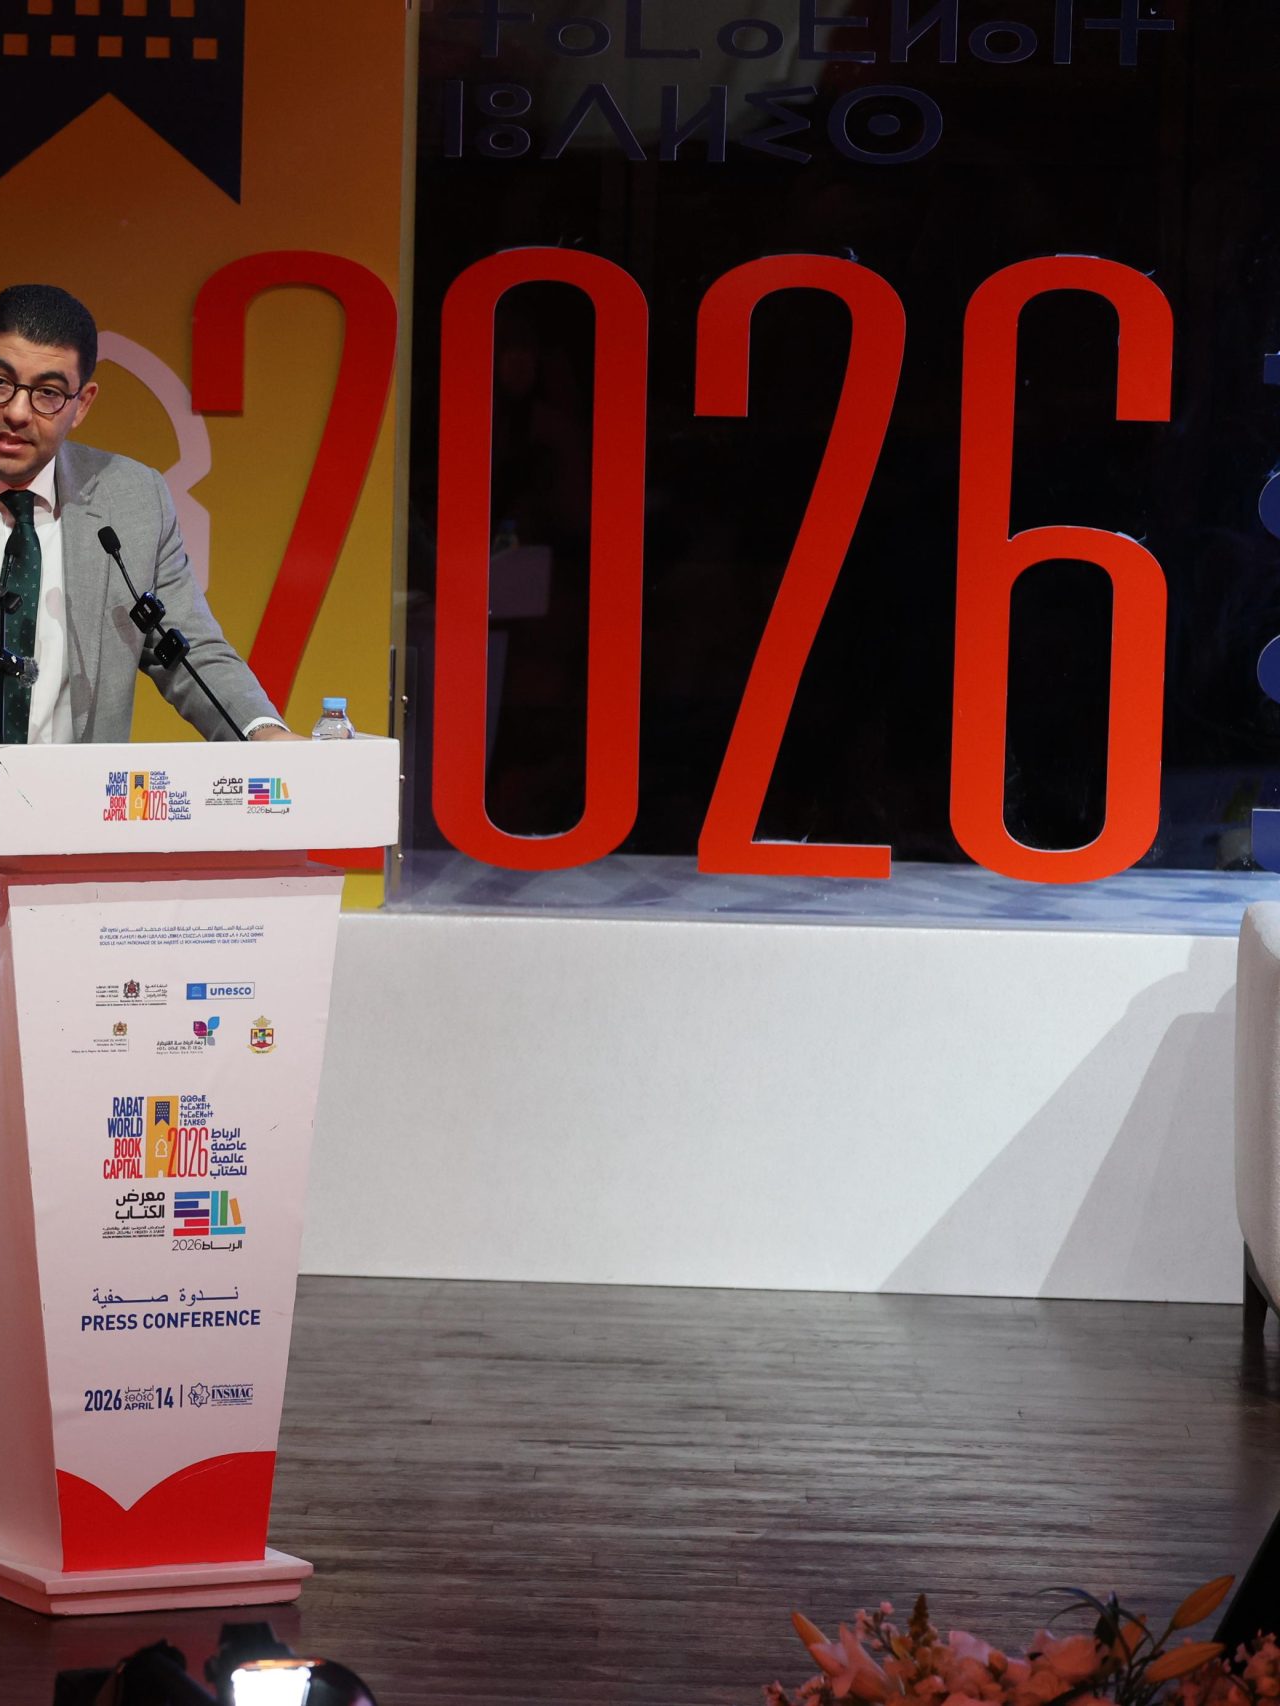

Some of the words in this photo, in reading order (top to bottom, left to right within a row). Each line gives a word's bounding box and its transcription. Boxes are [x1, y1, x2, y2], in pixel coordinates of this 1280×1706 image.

[191, 246, 1174, 885] 2026
[108, 771, 128, 784] RABAT
[212, 776, 244, 786] معرض
[106, 784, 128, 797] WORLD
[109, 796, 127, 809] BOOK
[142, 790, 168, 821] 2026
[103, 808, 128, 822] CAPITAL
[210, 986, 252, 996] unesco
[113, 1096, 144, 1118] RABAT
[108, 1117, 143, 1138] WORLD
[211, 1128, 240, 1141] الرباط
[114, 1138, 141, 1158] BOOK
[168, 1127, 208, 1178] 2026
[210, 1140, 247, 1151] عاصمة
[210, 1152, 244, 1166] عالمية
[103, 1158, 143, 1180] CAPITAL
[210, 1165, 247, 1179] للكتاب
[116, 1189, 165, 1206] معرض
[115, 1204, 165, 1223] الكتاب
[172, 1239, 202, 1251] 2026
[202, 1240, 242, 1252] الرباط
[92, 1288, 169, 1309] صحفية
[179, 1286, 239, 1306] ندوة
[81, 1314, 138, 1332] PRESS
[143, 1310, 261, 1329] CONFERENCE
[84, 1390, 122, 1412] 2026
[124, 1402, 154, 1411] APRIL
[156, 1388, 174, 1408] 14
[211, 1387, 254, 1399] INSMAC
